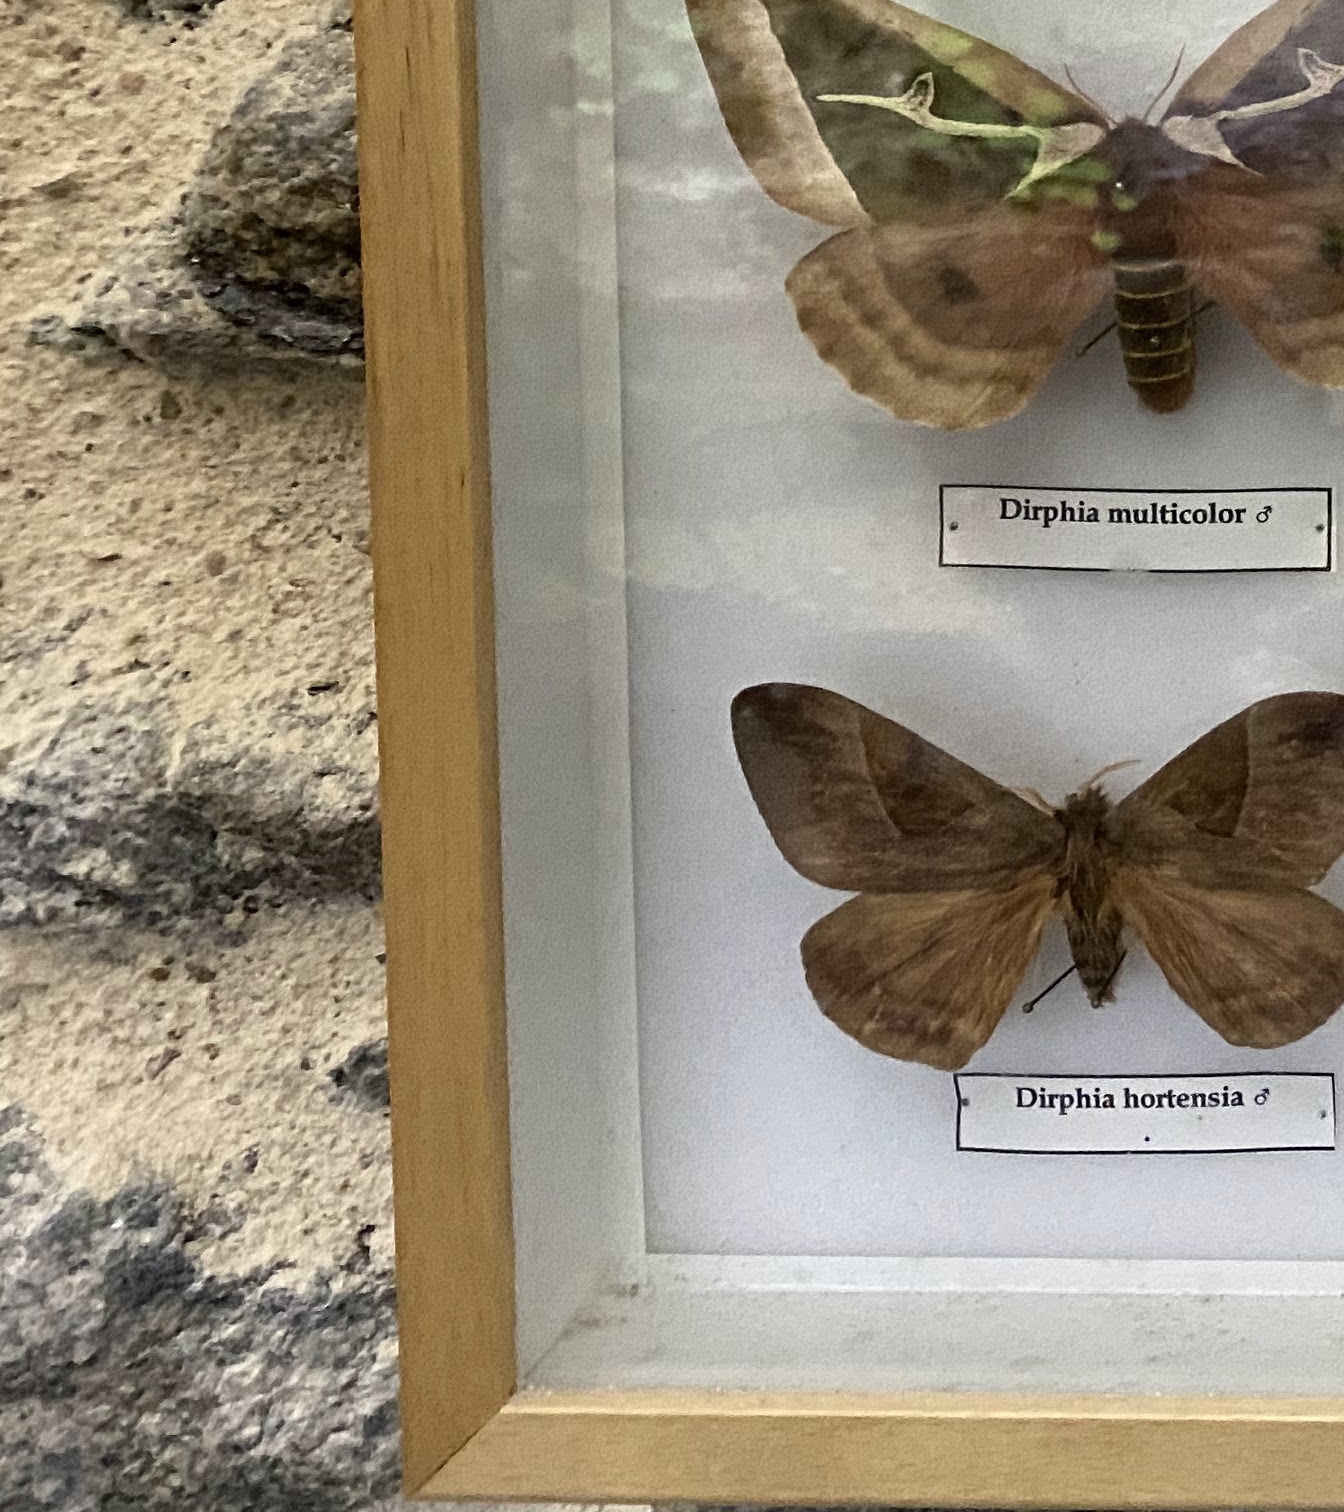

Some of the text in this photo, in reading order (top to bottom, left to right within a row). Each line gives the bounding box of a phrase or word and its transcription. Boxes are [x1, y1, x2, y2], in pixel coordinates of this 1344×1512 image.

[999, 497, 1246, 528] Dirphia multicolor
[1015, 1086, 1245, 1115] Dirphia hortensia
